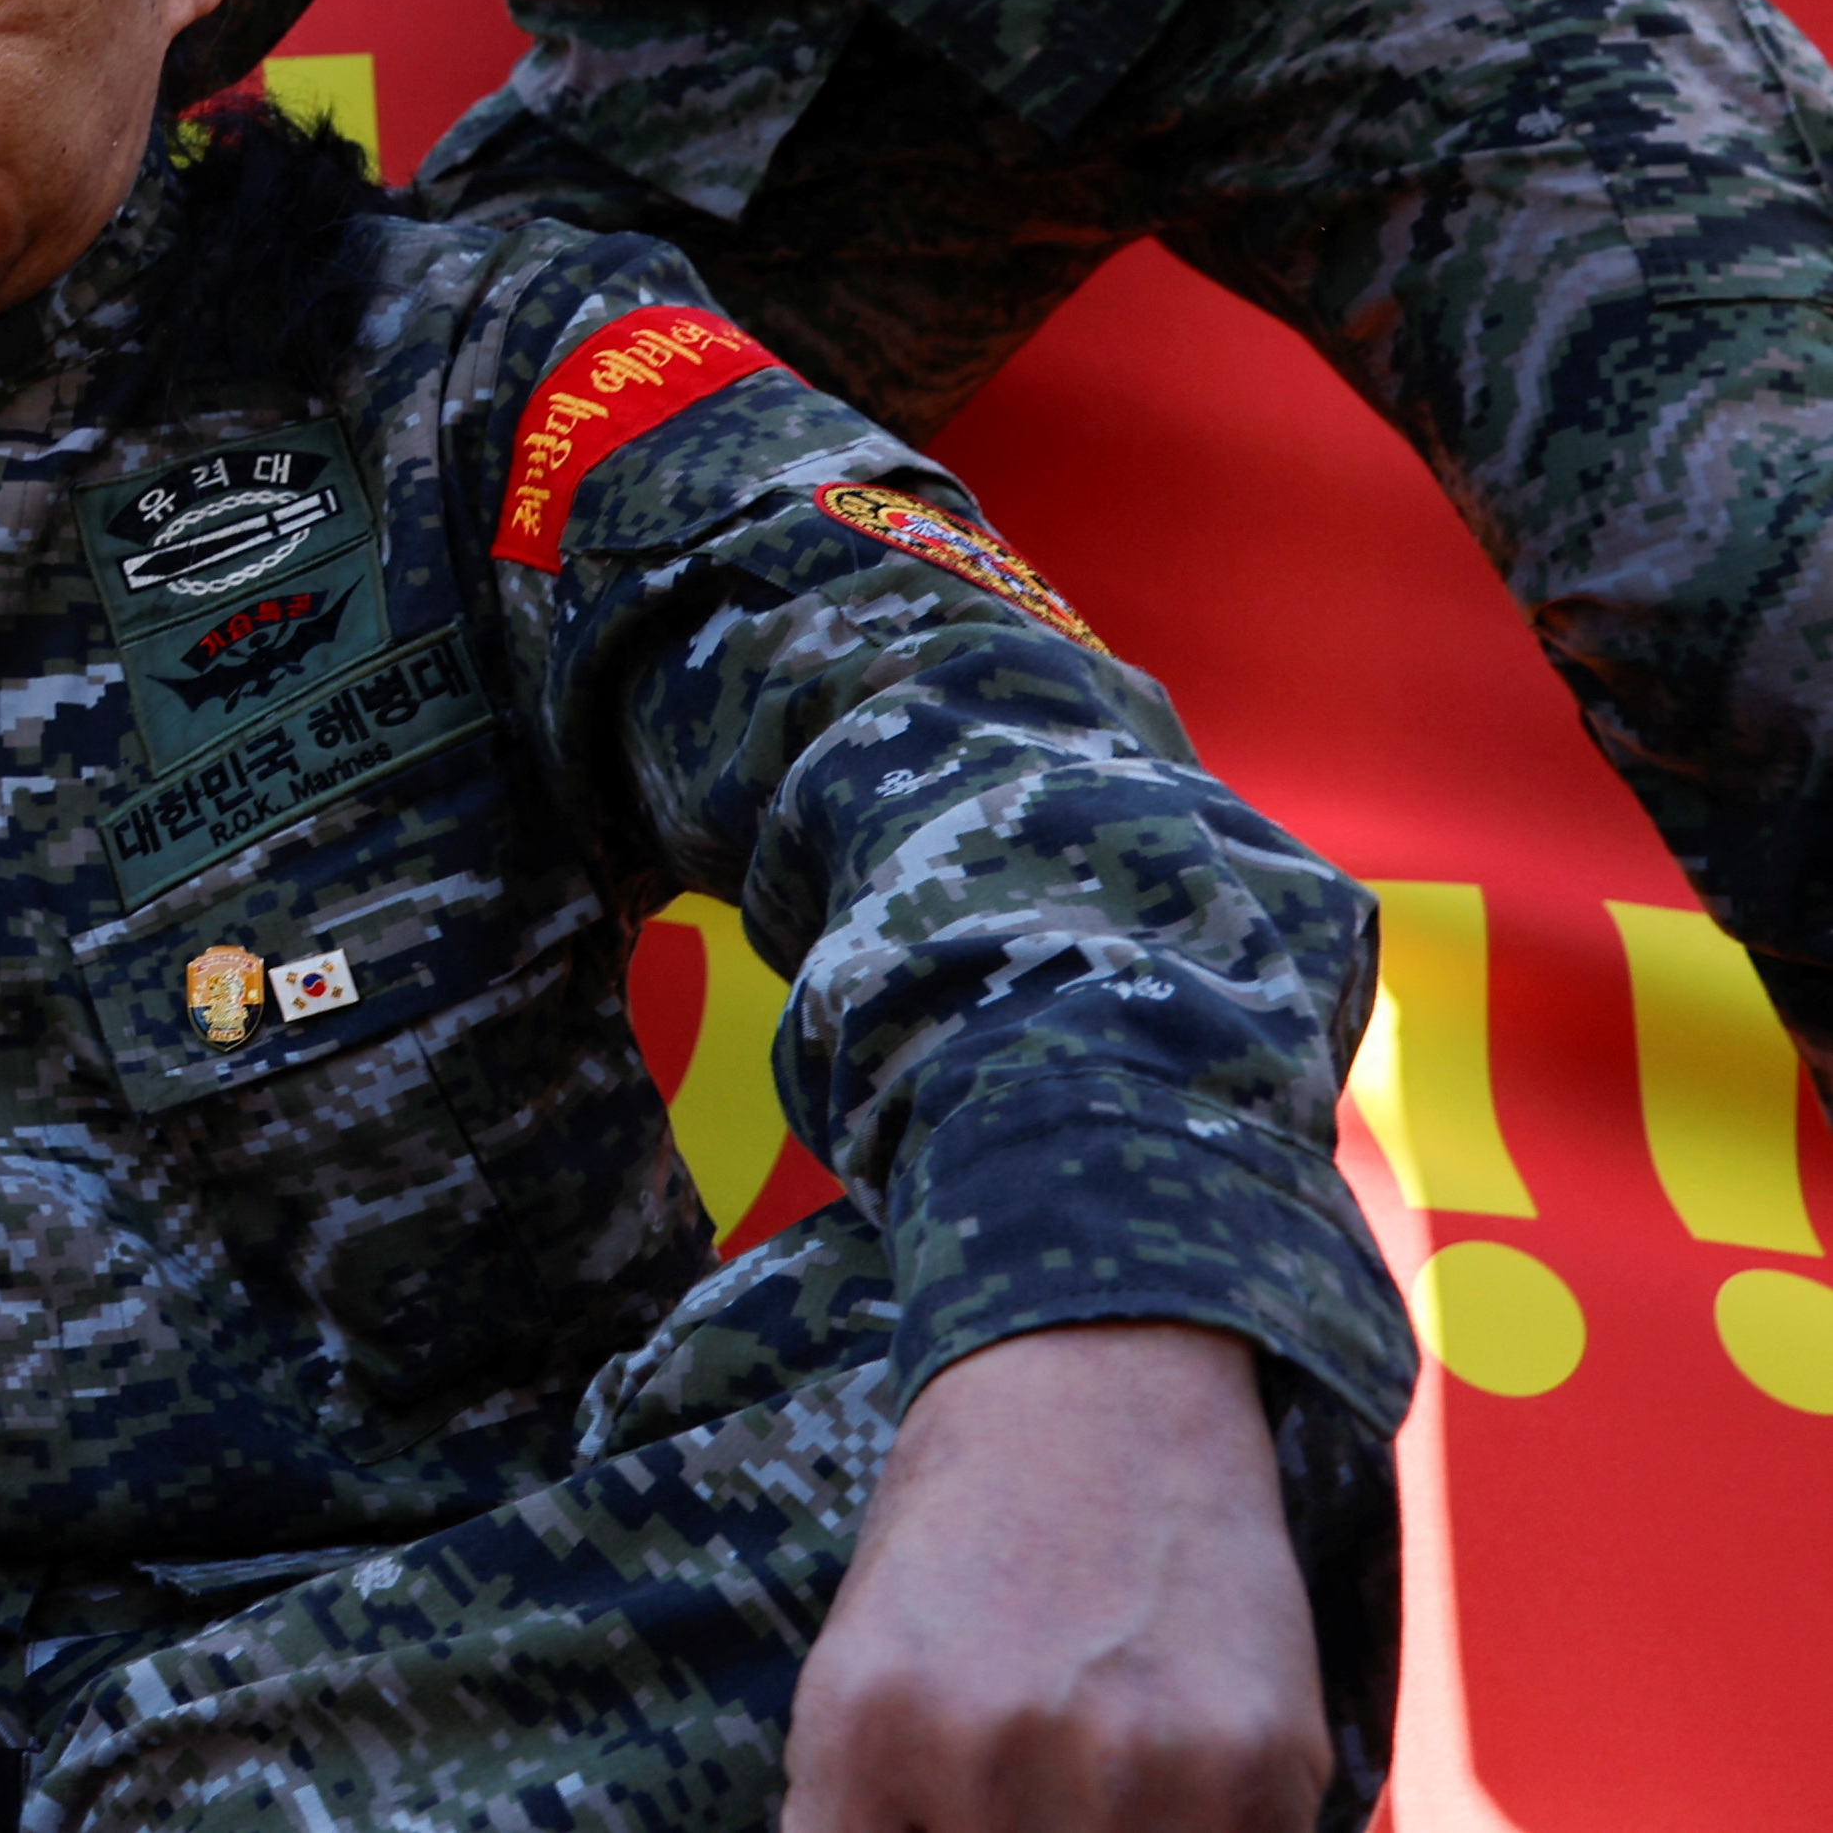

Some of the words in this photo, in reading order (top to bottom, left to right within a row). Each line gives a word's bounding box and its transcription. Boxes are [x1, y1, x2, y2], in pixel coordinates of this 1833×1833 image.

[137, 453, 293, 523] 유격대
[113, 726, 301, 861] 대한민국
[307, 644, 471, 751] 해병대
[289, 738, 393, 804] Marines
